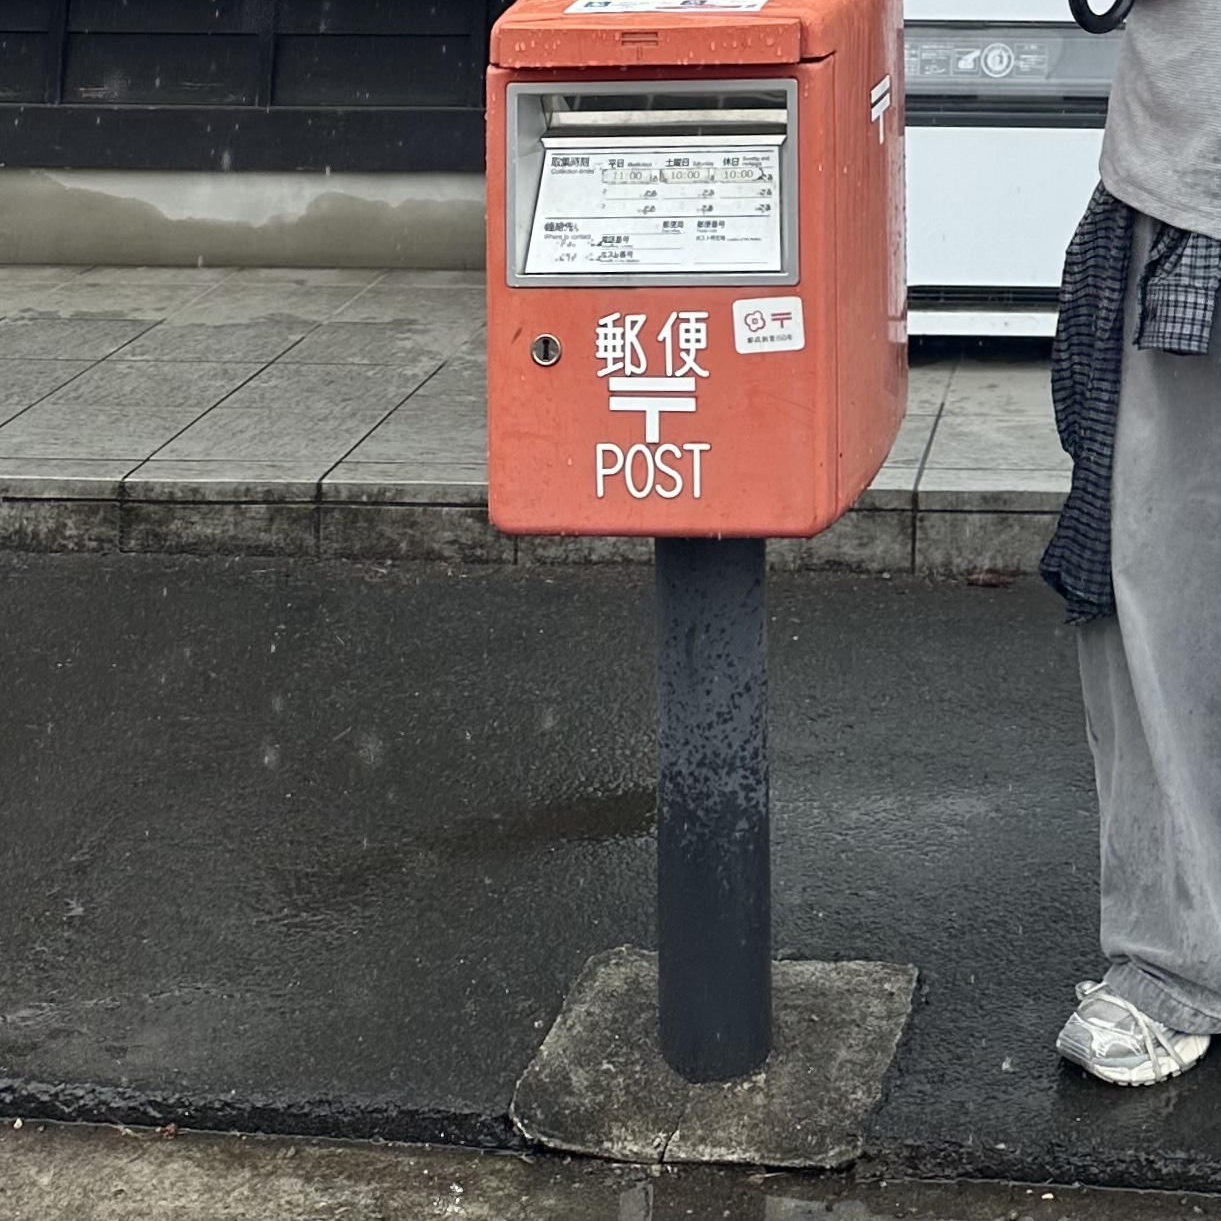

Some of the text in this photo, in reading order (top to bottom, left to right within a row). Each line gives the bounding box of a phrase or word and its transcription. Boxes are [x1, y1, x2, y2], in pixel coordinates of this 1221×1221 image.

[608, 159, 624, 168] 平日
[613, 171, 643, 180] 11:00
[671, 170, 700, 179] 10:00
[724, 169, 754, 179] 10:00
[595, 311, 710, 377] 郵便
[595, 443, 711, 498] POST
